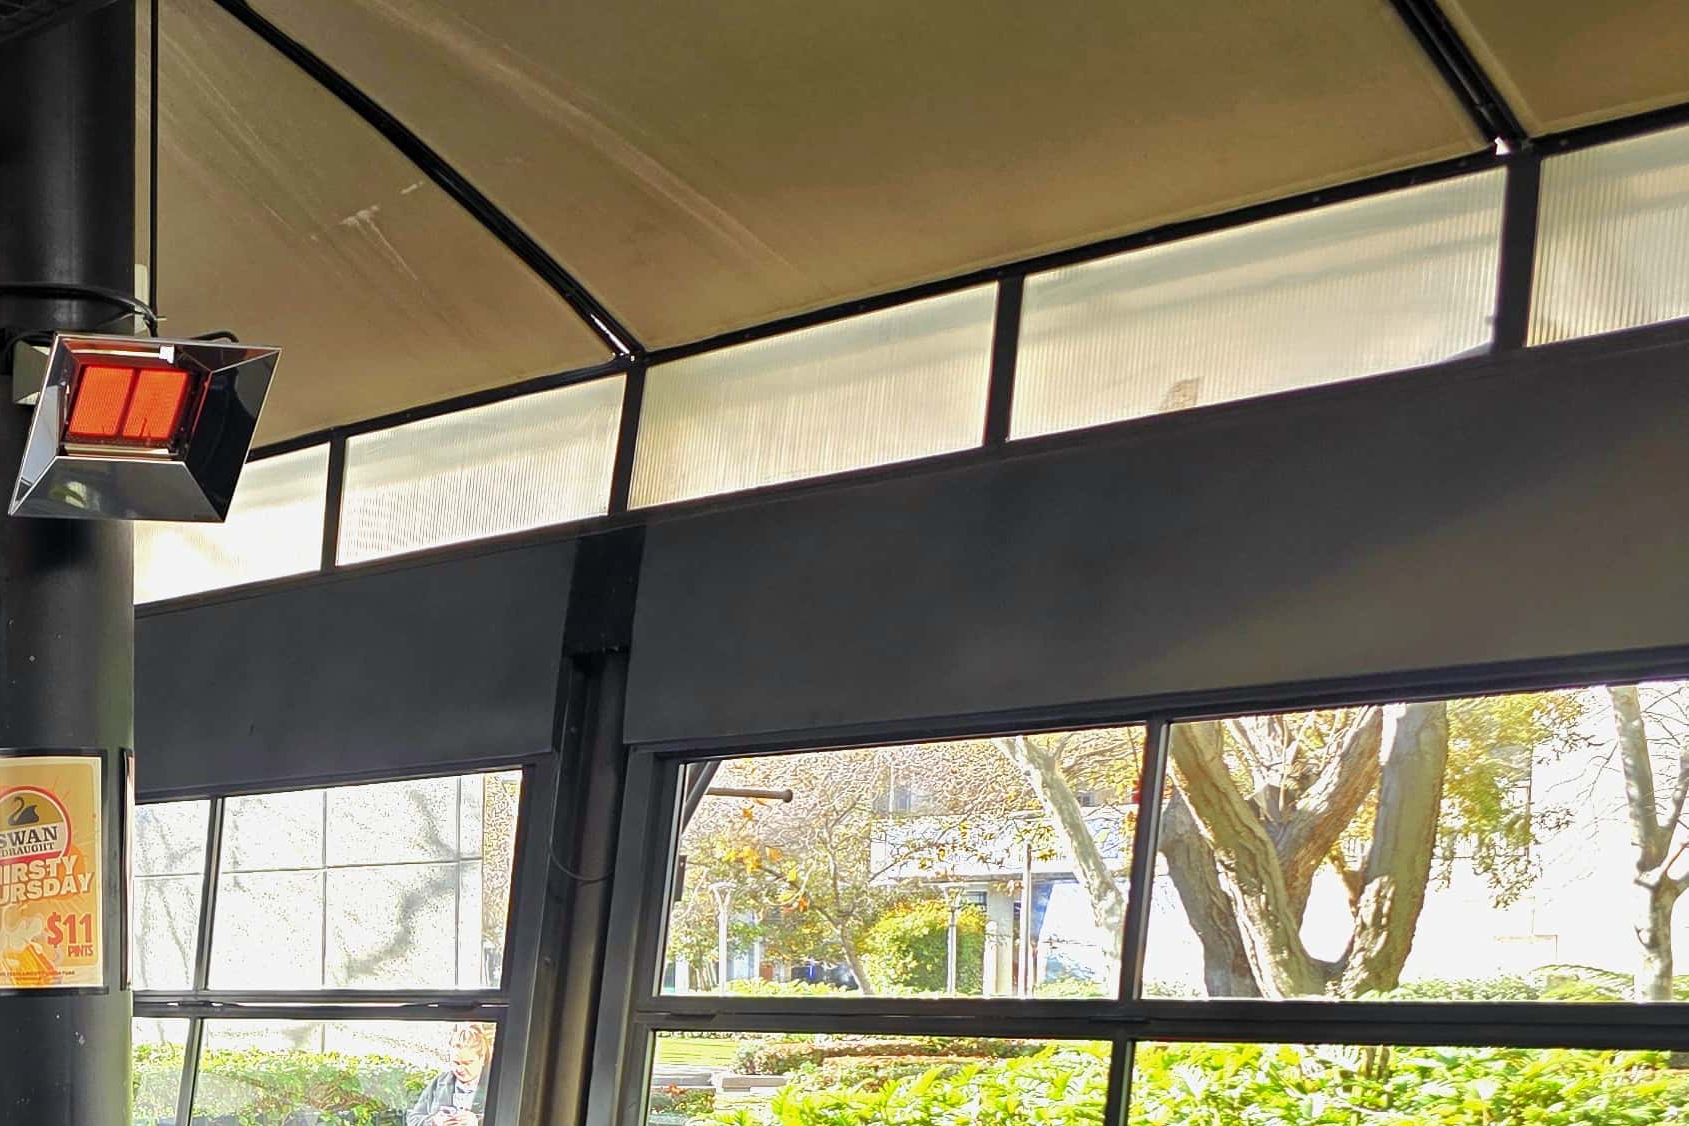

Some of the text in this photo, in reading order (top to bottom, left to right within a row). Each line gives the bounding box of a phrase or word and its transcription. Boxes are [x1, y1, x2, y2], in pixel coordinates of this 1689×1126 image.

[1, 842, 55, 858] DRAUGHT
[46, 911, 93, 949] $11
[68, 944, 94, 957] PINTS
